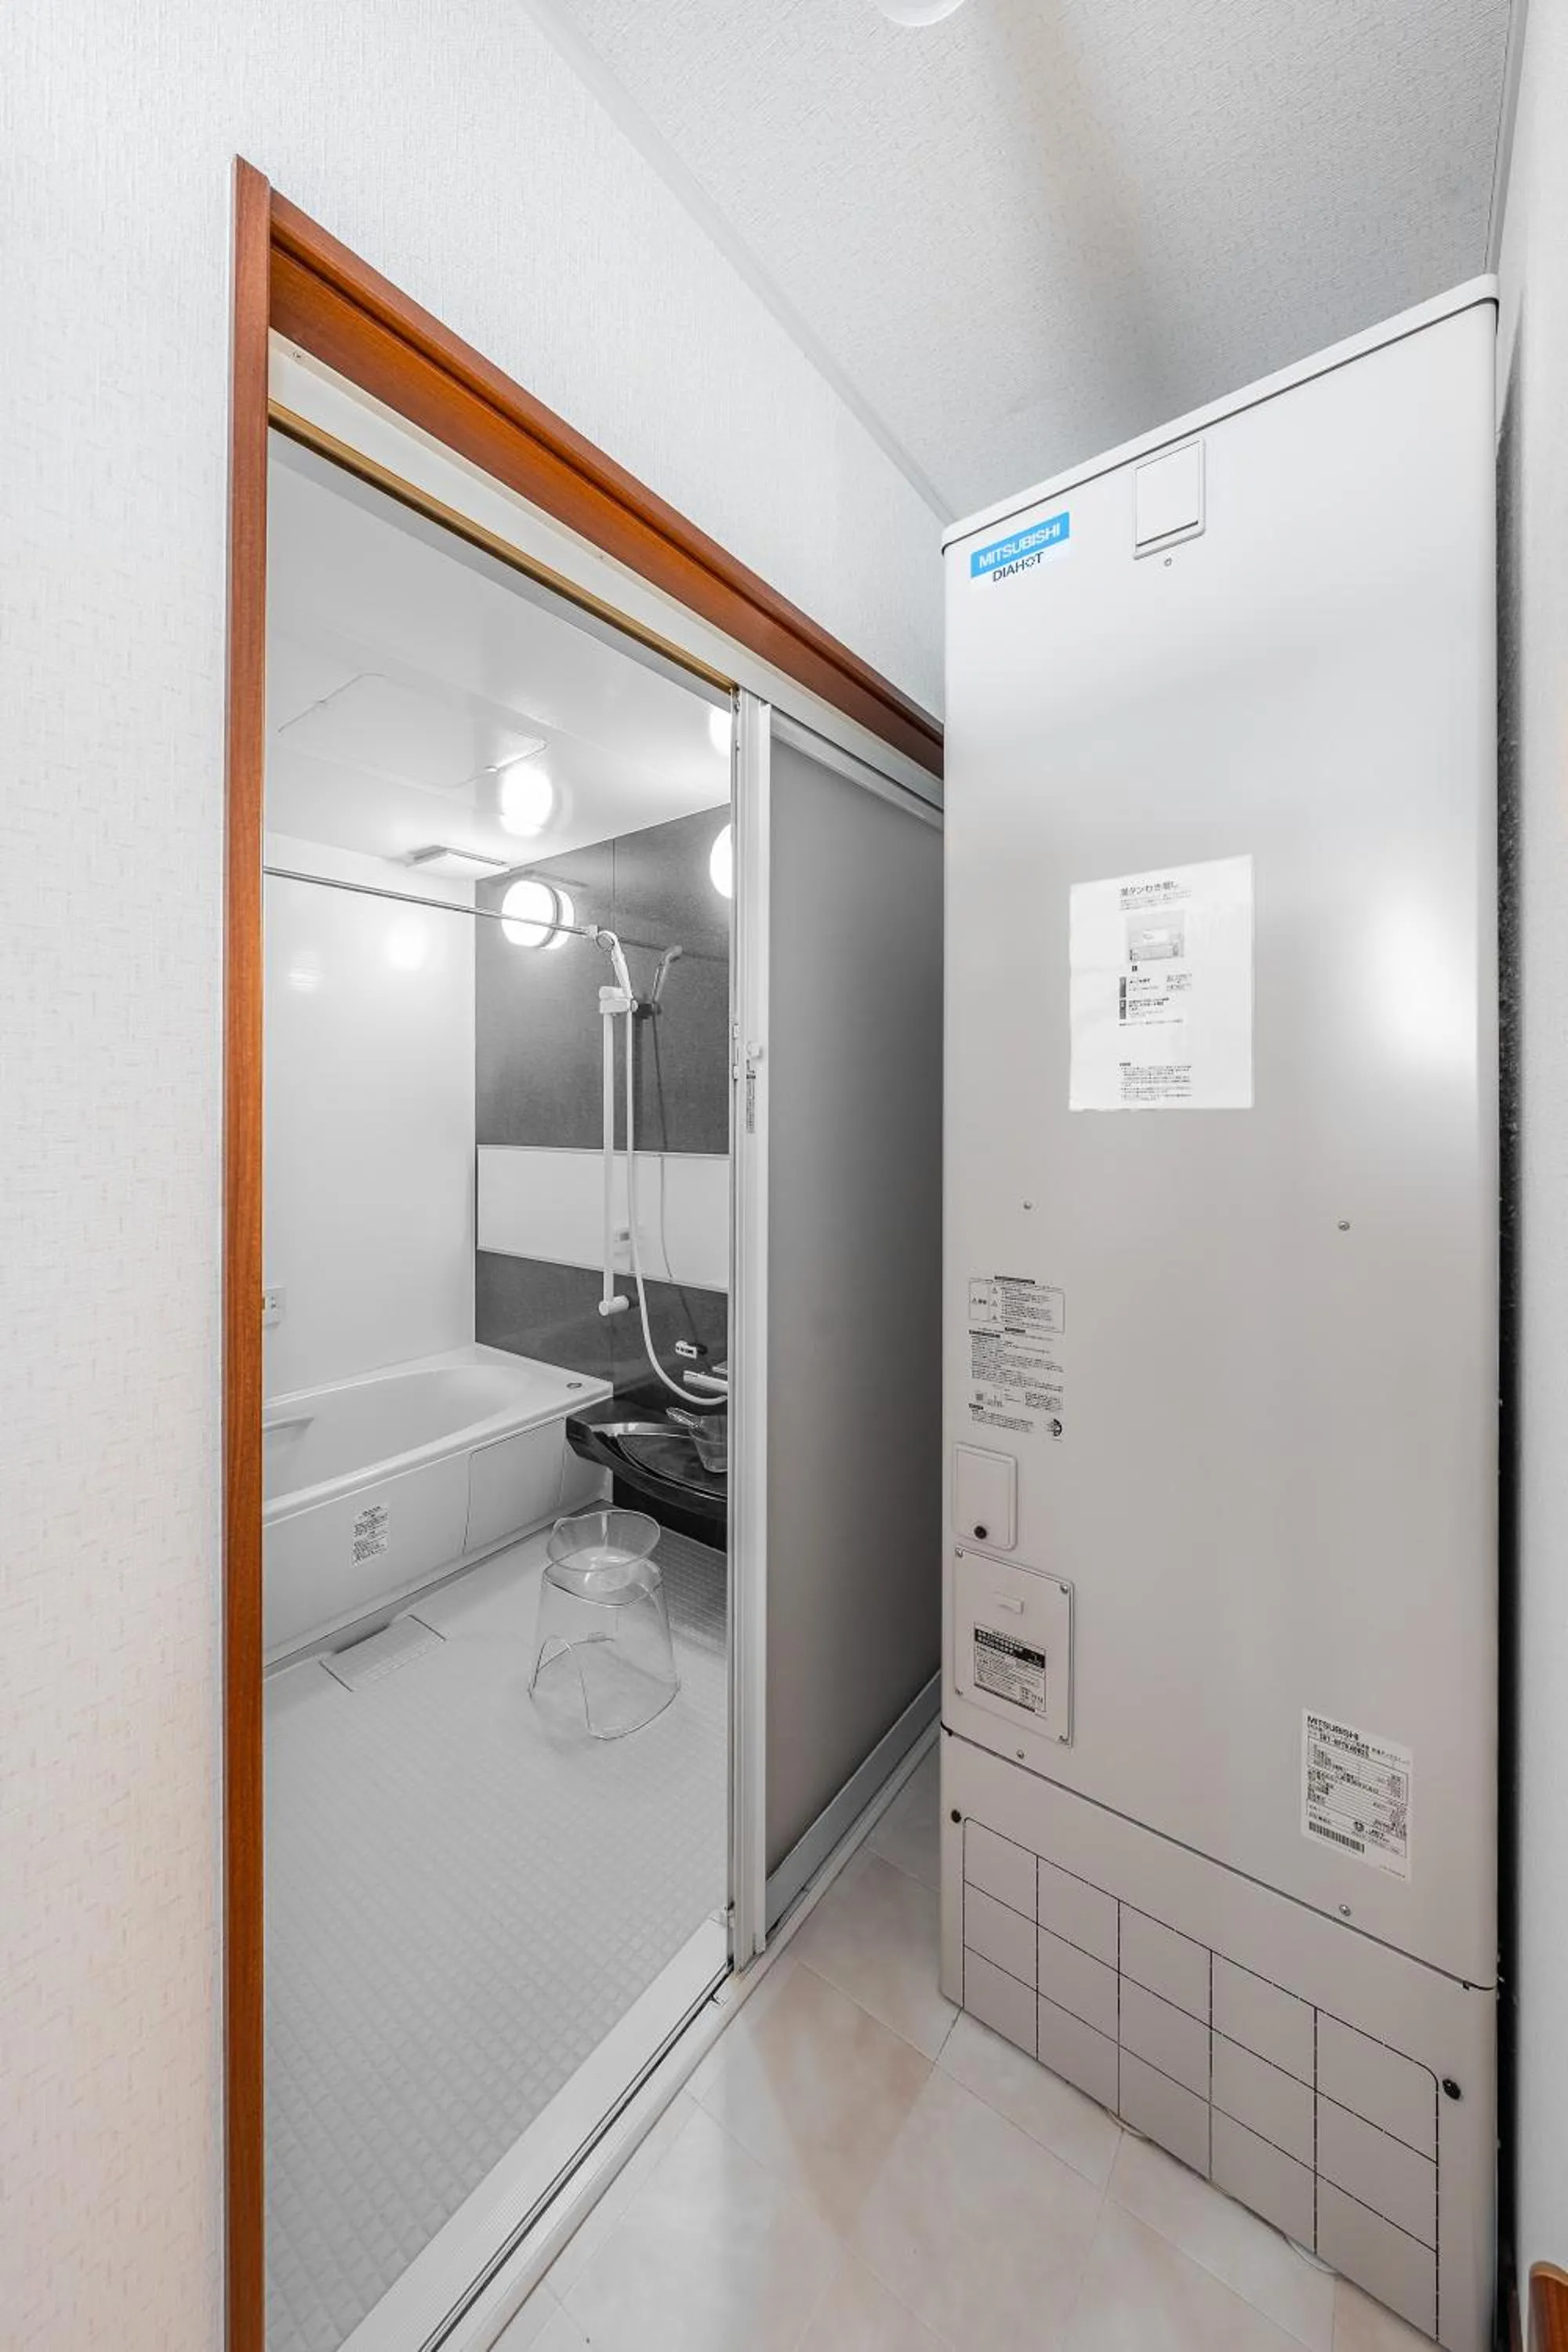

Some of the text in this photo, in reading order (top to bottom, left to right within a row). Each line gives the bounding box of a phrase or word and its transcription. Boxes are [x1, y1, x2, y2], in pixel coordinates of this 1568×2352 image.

[979, 523, 1060, 568] MITSUBISHI
[993, 552, 1044, 582] DIAHOT
[1307, 1715, 1359, 1741] MITSUBISHI
